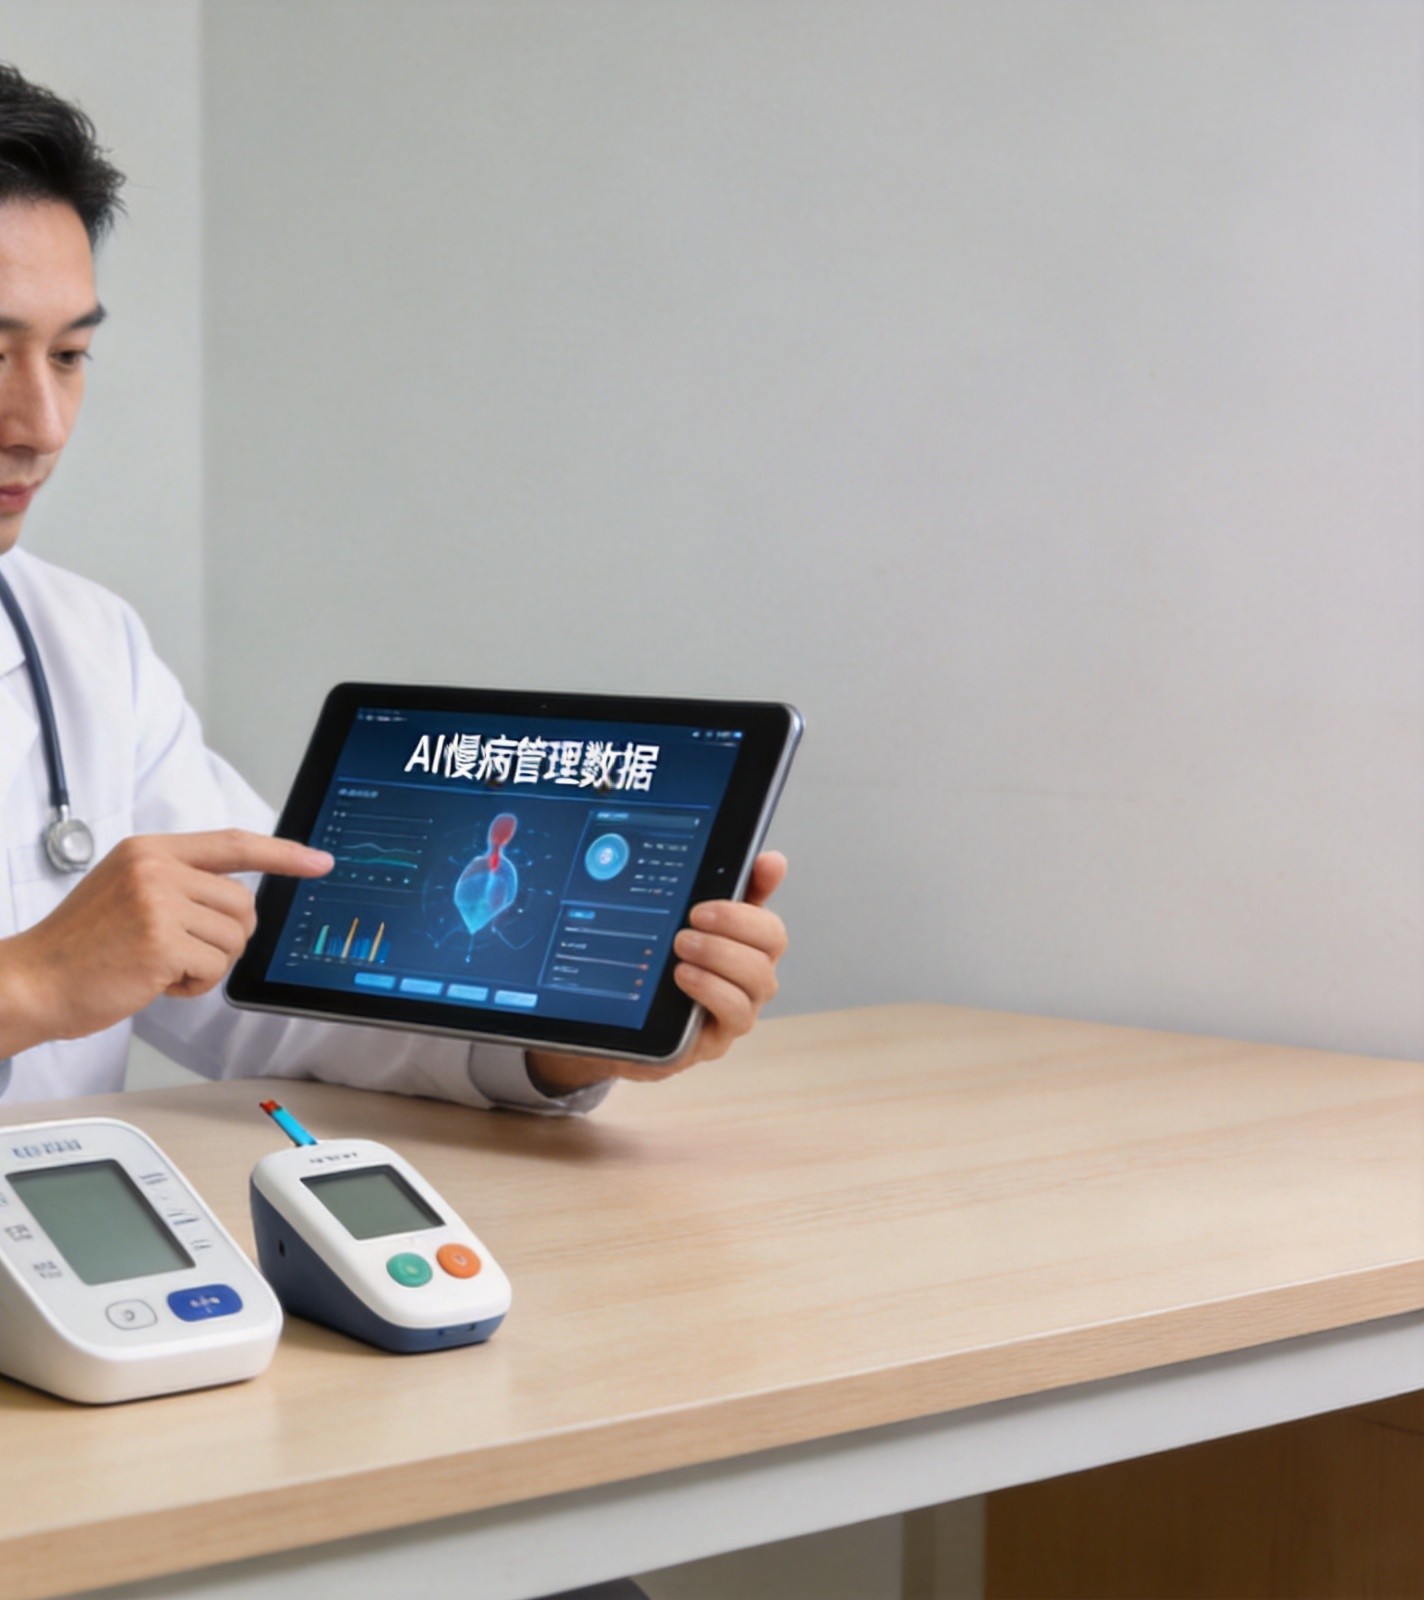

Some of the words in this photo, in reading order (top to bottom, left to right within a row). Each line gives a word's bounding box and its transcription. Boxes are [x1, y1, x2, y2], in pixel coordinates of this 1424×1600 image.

[404, 733, 660, 791] AI慢病管理数据
